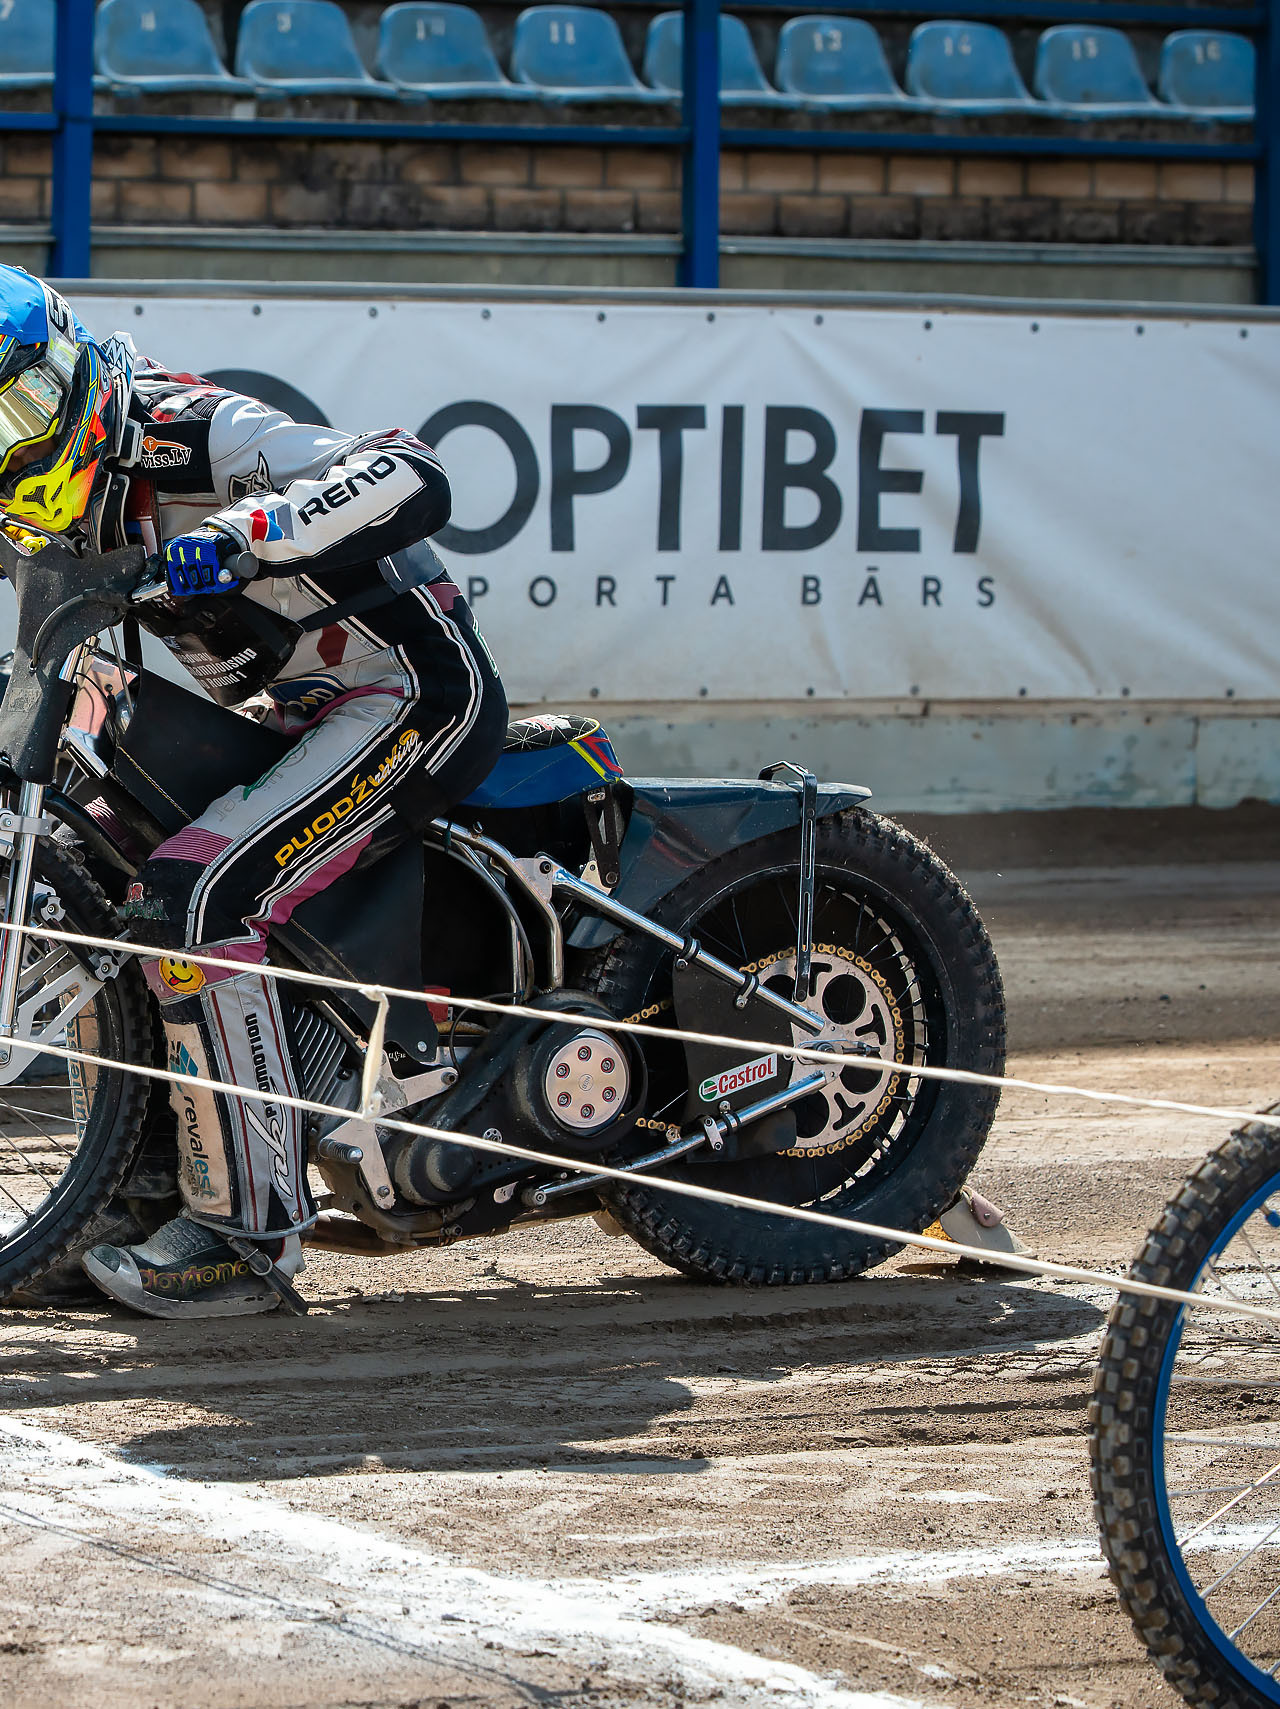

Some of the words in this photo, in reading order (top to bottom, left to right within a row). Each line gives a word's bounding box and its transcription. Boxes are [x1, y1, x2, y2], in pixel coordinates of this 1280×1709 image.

[297, 455, 397, 527] RENO
[417, 399, 1005, 555] OPTIBET
[467, 575, 736, 608] PORTA
[801, 567, 997, 608] BĀRS
[245, 1012, 278, 1119] POMOTION
[719, 1057, 774, 1095] Castrol
[183, 1095, 216, 1199] revalest
